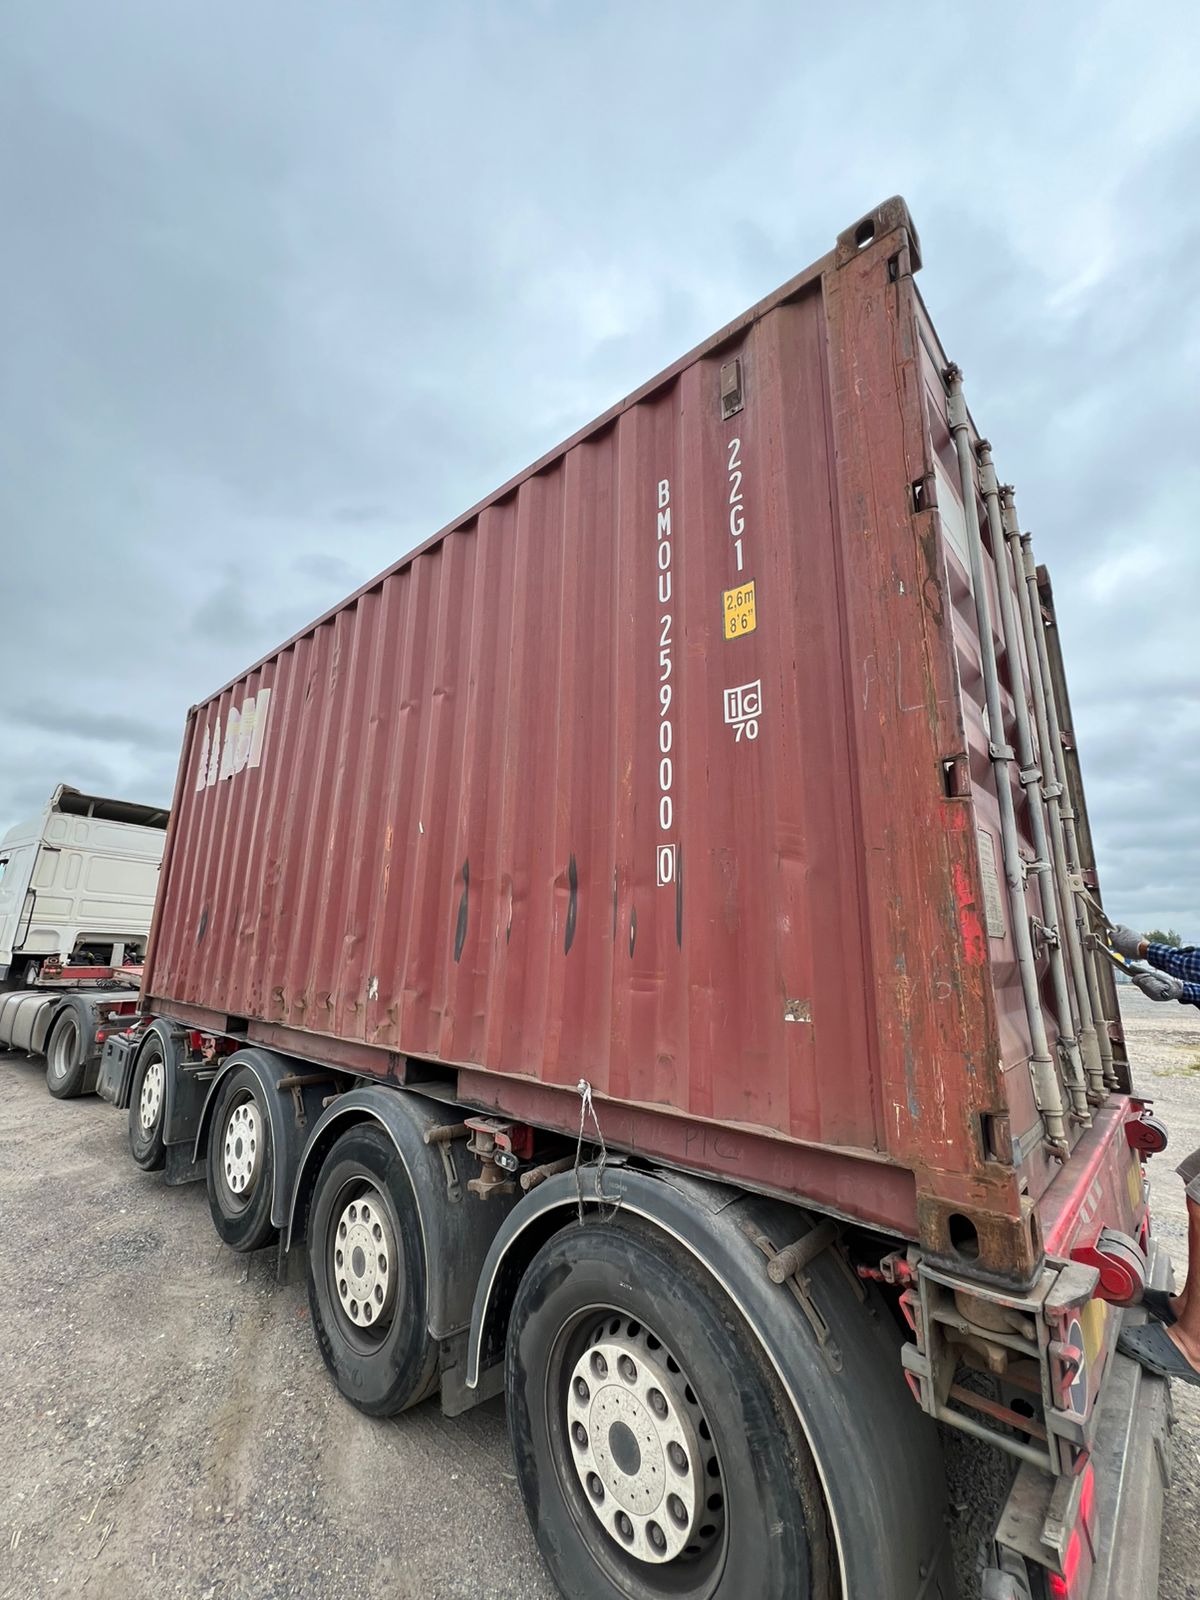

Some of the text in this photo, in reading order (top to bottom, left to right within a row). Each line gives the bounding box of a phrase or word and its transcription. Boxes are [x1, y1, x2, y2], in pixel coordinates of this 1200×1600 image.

[727, 437, 745, 572] 22G1
[726, 589, 754, 611] 2,6m
[657, 478, 673, 883] BMOU 259000 0
[732, 719, 759, 742] 70
